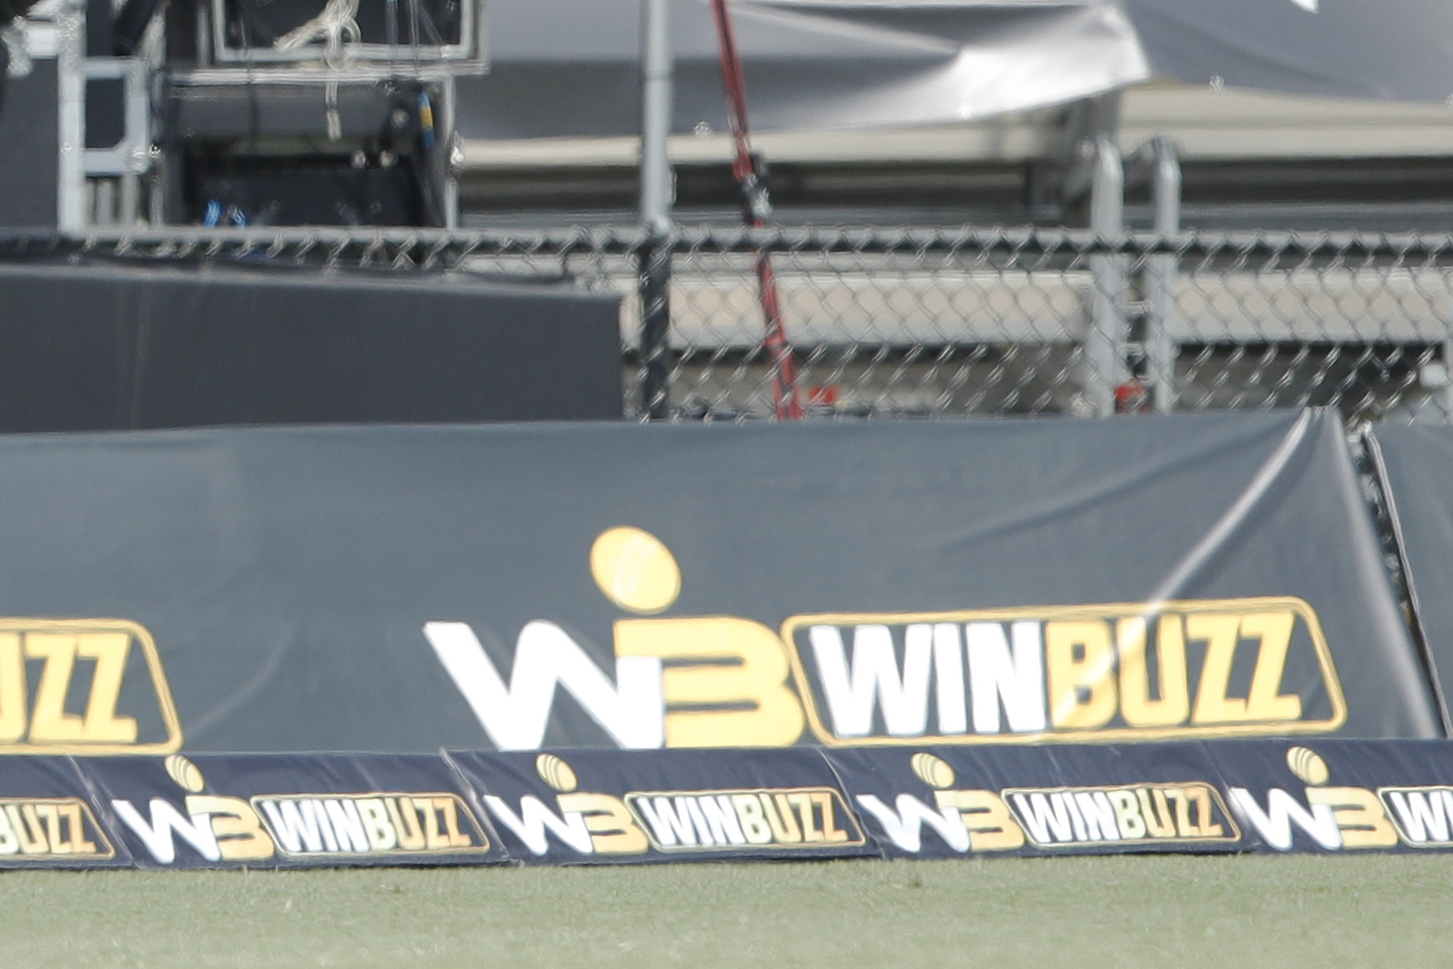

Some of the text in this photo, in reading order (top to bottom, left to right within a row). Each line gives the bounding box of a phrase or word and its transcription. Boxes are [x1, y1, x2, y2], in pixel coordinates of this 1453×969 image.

[810, 611, 1302, 739] WINBUZZ
[261, 796, 472, 853] WINBUZZ
[637, 792, 848, 847] WINBUZZ
[1013, 786, 1225, 844] WINBUZZ
